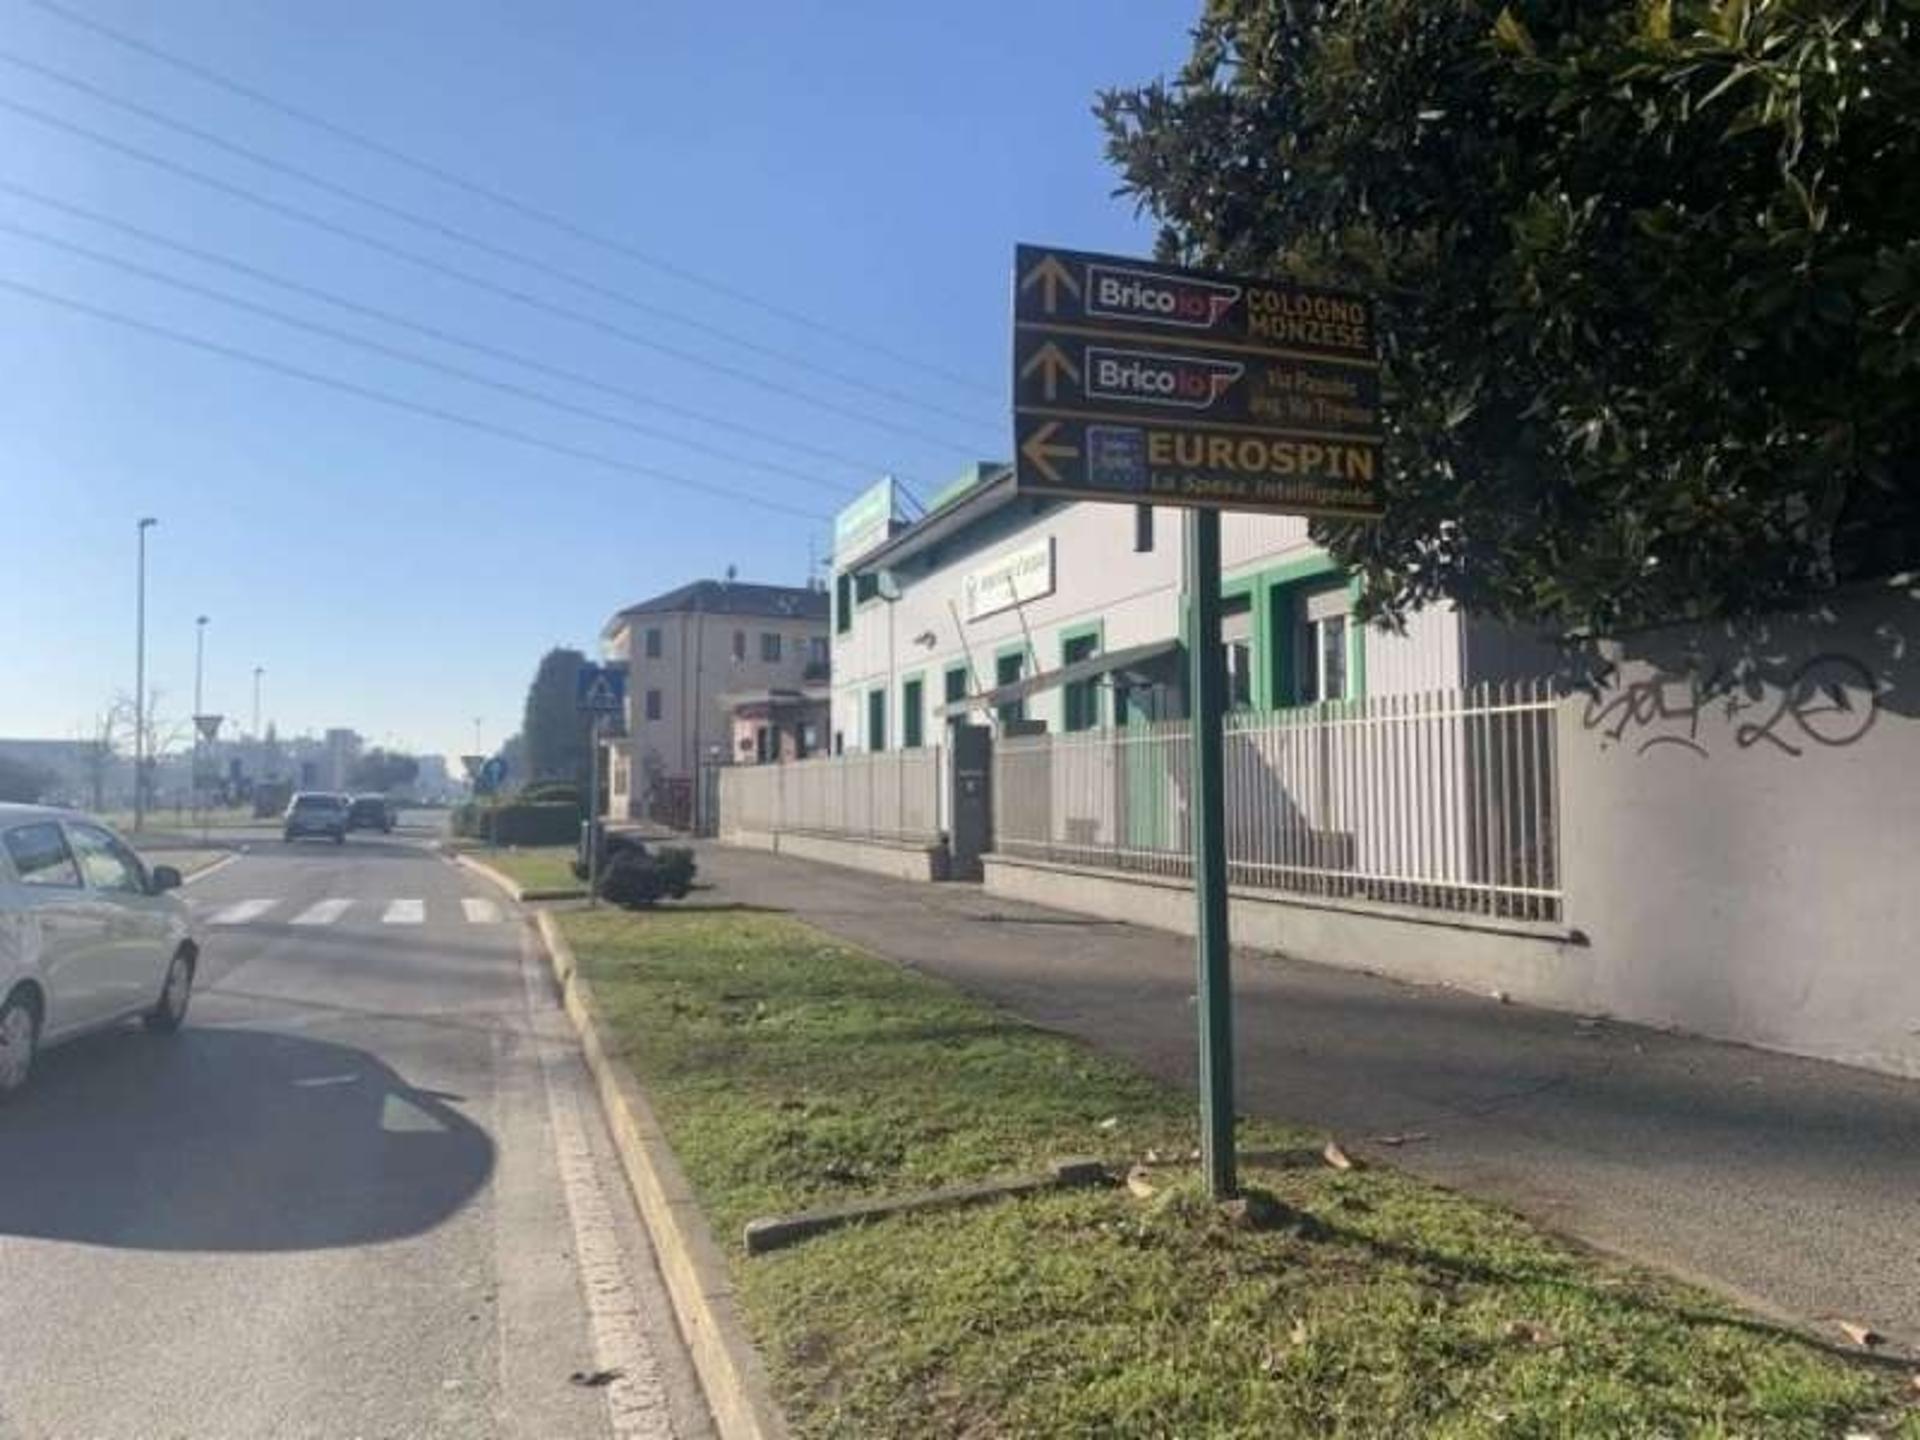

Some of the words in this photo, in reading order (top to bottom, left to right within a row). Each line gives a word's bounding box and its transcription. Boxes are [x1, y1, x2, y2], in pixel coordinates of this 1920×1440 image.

[1247, 287, 1365, 325] COLOGNO
[1248, 314, 1368, 349] MONZESE
[1148, 431, 1374, 480] EUROSPIN
